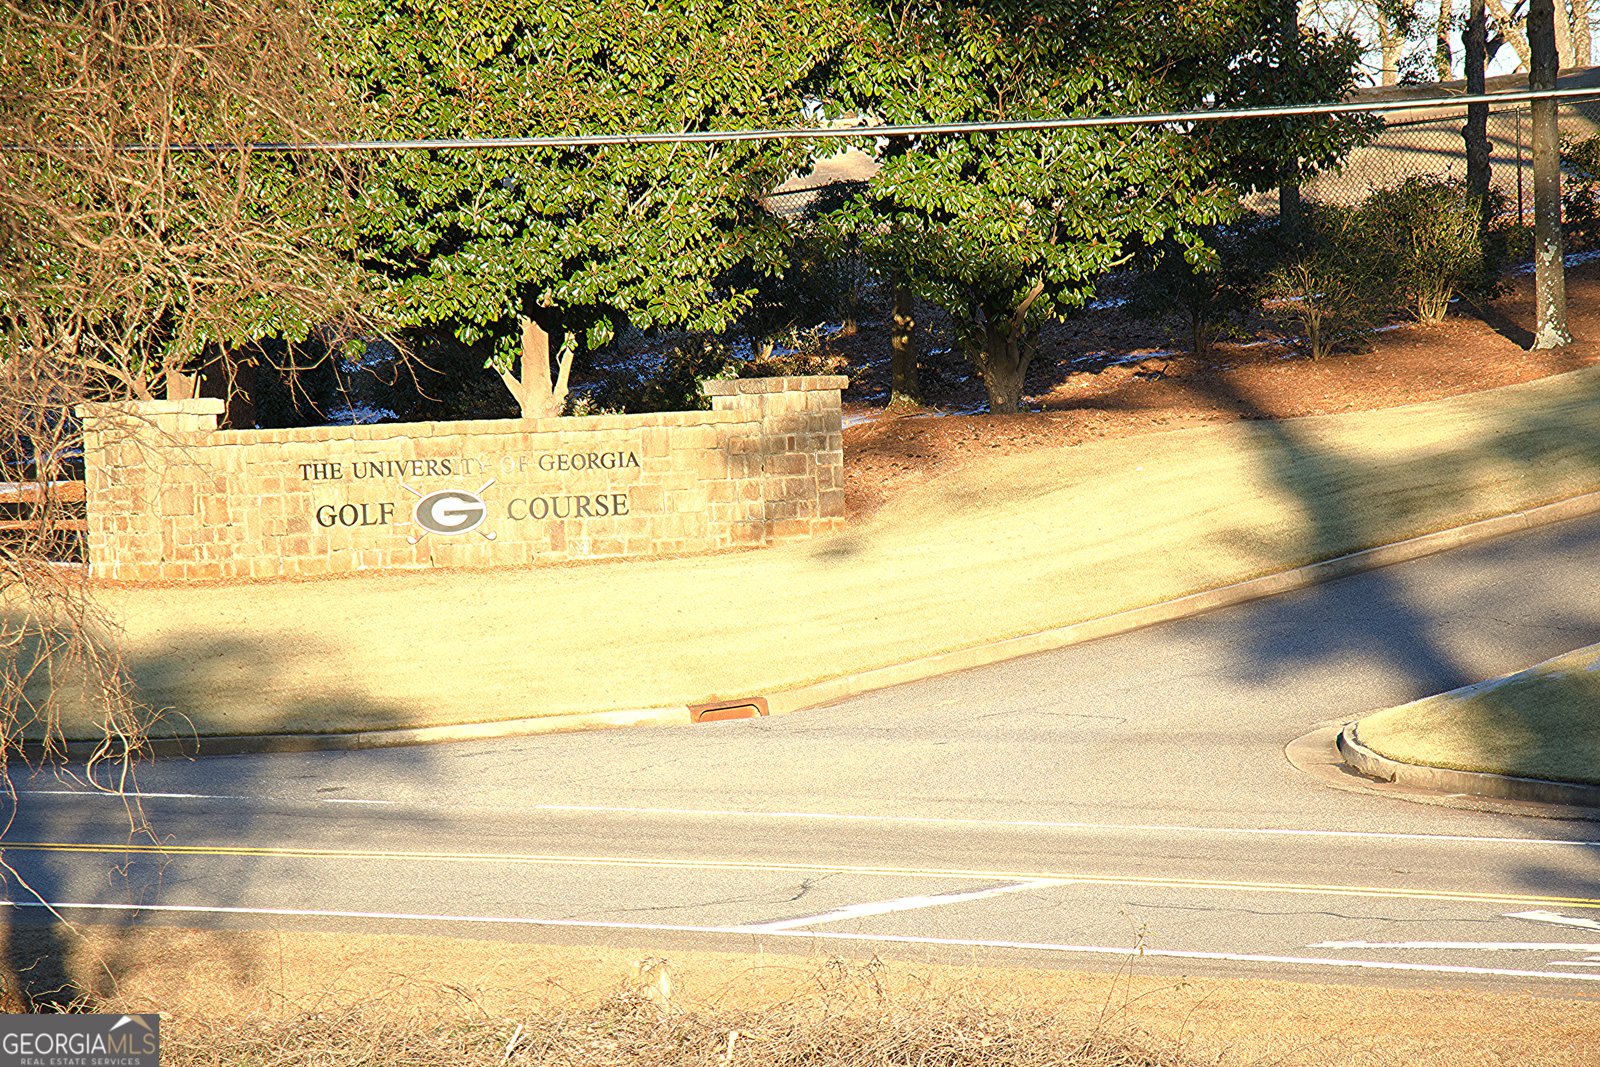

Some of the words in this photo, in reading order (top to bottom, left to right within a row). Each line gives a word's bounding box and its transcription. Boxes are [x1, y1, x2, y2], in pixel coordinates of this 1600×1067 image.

[299, 462, 344, 481] THE
[353, 458, 486, 479] UNIVERSITY
[501, 455, 529, 474] OF
[538, 451, 641, 472] GEORGIA
[316, 502, 396, 528] GOLF
[507, 493, 630, 521] COURSE
